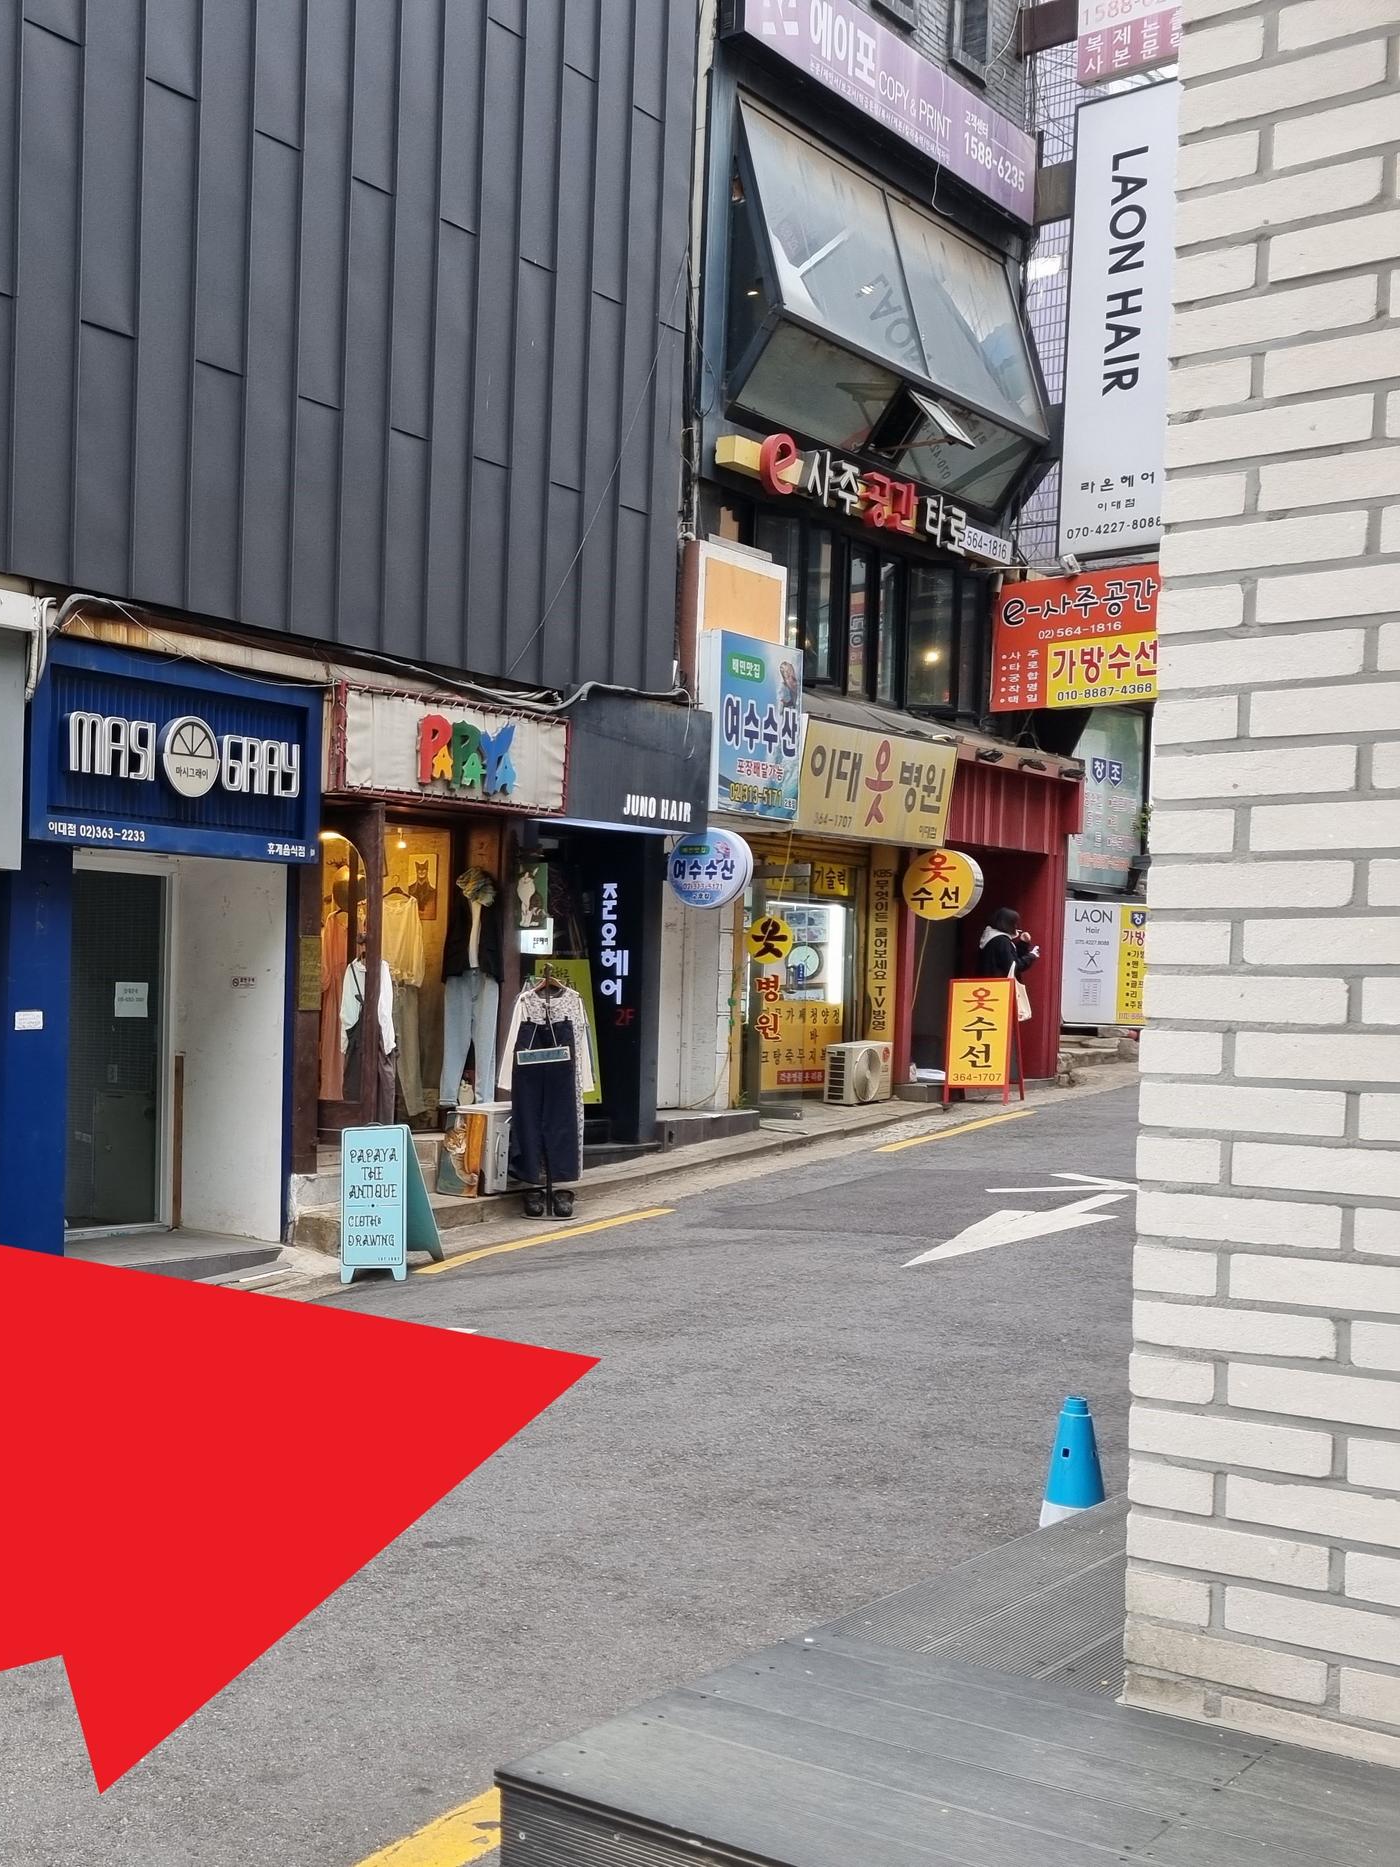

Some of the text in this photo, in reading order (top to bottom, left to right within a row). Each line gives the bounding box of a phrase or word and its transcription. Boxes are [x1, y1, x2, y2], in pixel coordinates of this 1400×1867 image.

[809, 0, 876, 88] 에이포
[1085, 34, 1104, 73] 복사
[1111, 24, 1131, 68] 제본
[1140, 18, 1160, 60] 논문
[879, 70, 952, 141] COPY & PRINT
[964, 110, 989, 139] 고객센터
[964, 131, 1025, 193] 1588-6235
[1102, 145, 1149, 396] LAON HAIR
[1080, 472, 1155, 493] 라온헤어
[1098, 498, 1135, 511] 이대점
[925, 495, 967, 557] 타로
[966, 531, 1008, 560] 564-1816
[1003, 580, 1158, 626] e-사주공간
[1052, 640, 1158, 684] 가방수선
[1057, 683, 1152, 701] 010-8887-4368
[724, 694, 798, 758] 여수수산
[66, 711, 157, 782] MASI
[417, 713, 517, 797] PAPAYA
[220, 734, 301, 798] GRAY
[736, 758, 784, 781] 포장배달가능
[810, 739, 946, 827] 이대 옷 병원
[623, 794, 692, 823] JUNO HAIR
[48, 821, 146, 843] 이대점 02)363-2233
[673, 859, 736, 881] 여수수산
[920, 853, 957, 885] 옷
[874, 880, 889, 923] 무엇이든
[911, 887, 960, 911] 수선
[1075, 908, 1113, 924] LAON
[601, 883, 629, 1005] 준오헤어
[1085, 926, 1101, 934] Hair
[873, 927, 888, 981] 물어보세요
[615, 1008, 636, 1026] 2F
[756, 974, 781, 1041] 병원
[962, 987, 1000, 1013] 옷
[959, 1016, 998, 1069] 수선
[953, 1073, 1002, 1082] 364-1707
[349, 1147, 399, 1164] PAPAYA
[348, 1183, 398, 1199] ANTIQUE
[361, 1166, 384, 1181] THE
[348, 1234, 395, 1247] DRAWING
